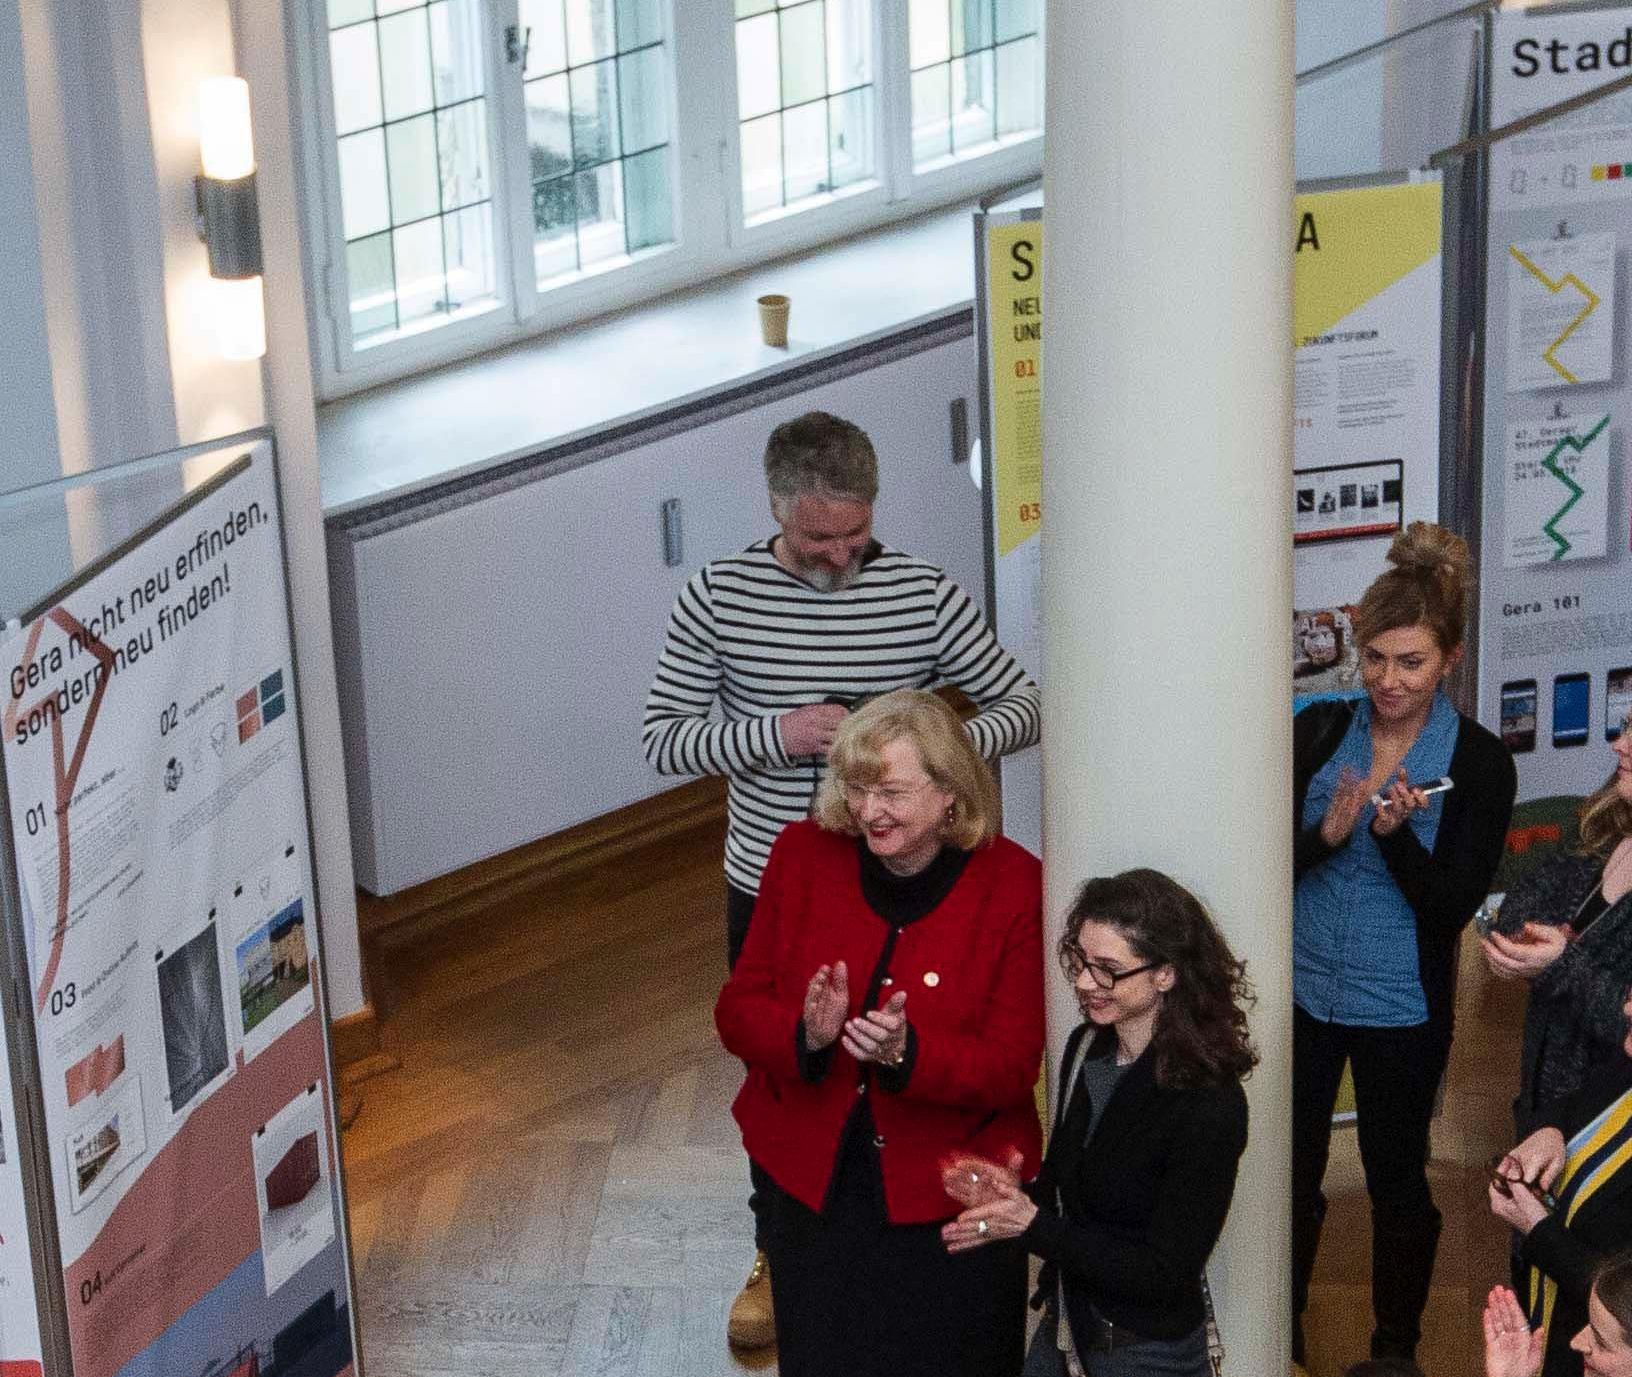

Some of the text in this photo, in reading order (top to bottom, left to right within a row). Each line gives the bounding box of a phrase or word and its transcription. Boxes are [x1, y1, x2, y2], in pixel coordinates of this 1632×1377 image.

[10, 500, 268, 700] Gera nicht neu erfinden,
[1502, 596, 1581, 618] Gera 101
[16, 560, 232, 745] sondern neu finden!
[159, 701, 178, 737] 02
[25, 802, 47, 837] 01
[50, 981, 77, 1016] 03
[81, 1270, 103, 1305] 04
